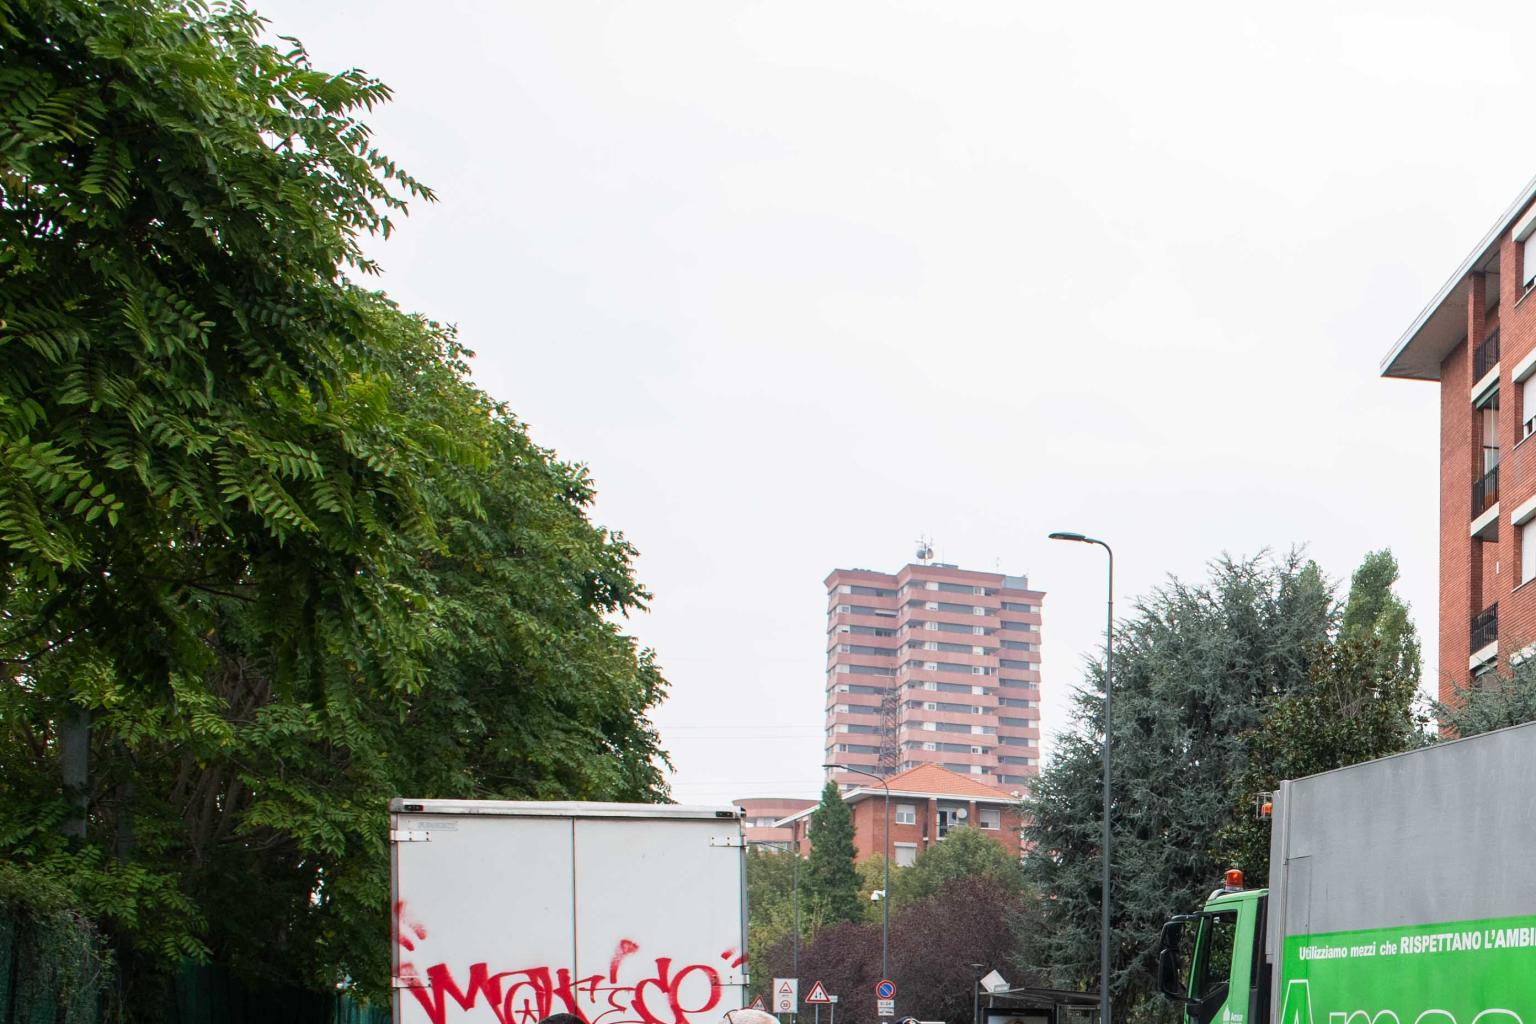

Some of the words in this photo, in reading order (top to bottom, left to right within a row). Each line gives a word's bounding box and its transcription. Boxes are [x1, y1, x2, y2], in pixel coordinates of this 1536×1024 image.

[1299, 945, 1348, 960] Utilizziamo
[1350, 941, 1377, 958] mezzi
[1379, 940, 1398, 956] che
[1400, 931, 1482, 954] RISPETTANO
